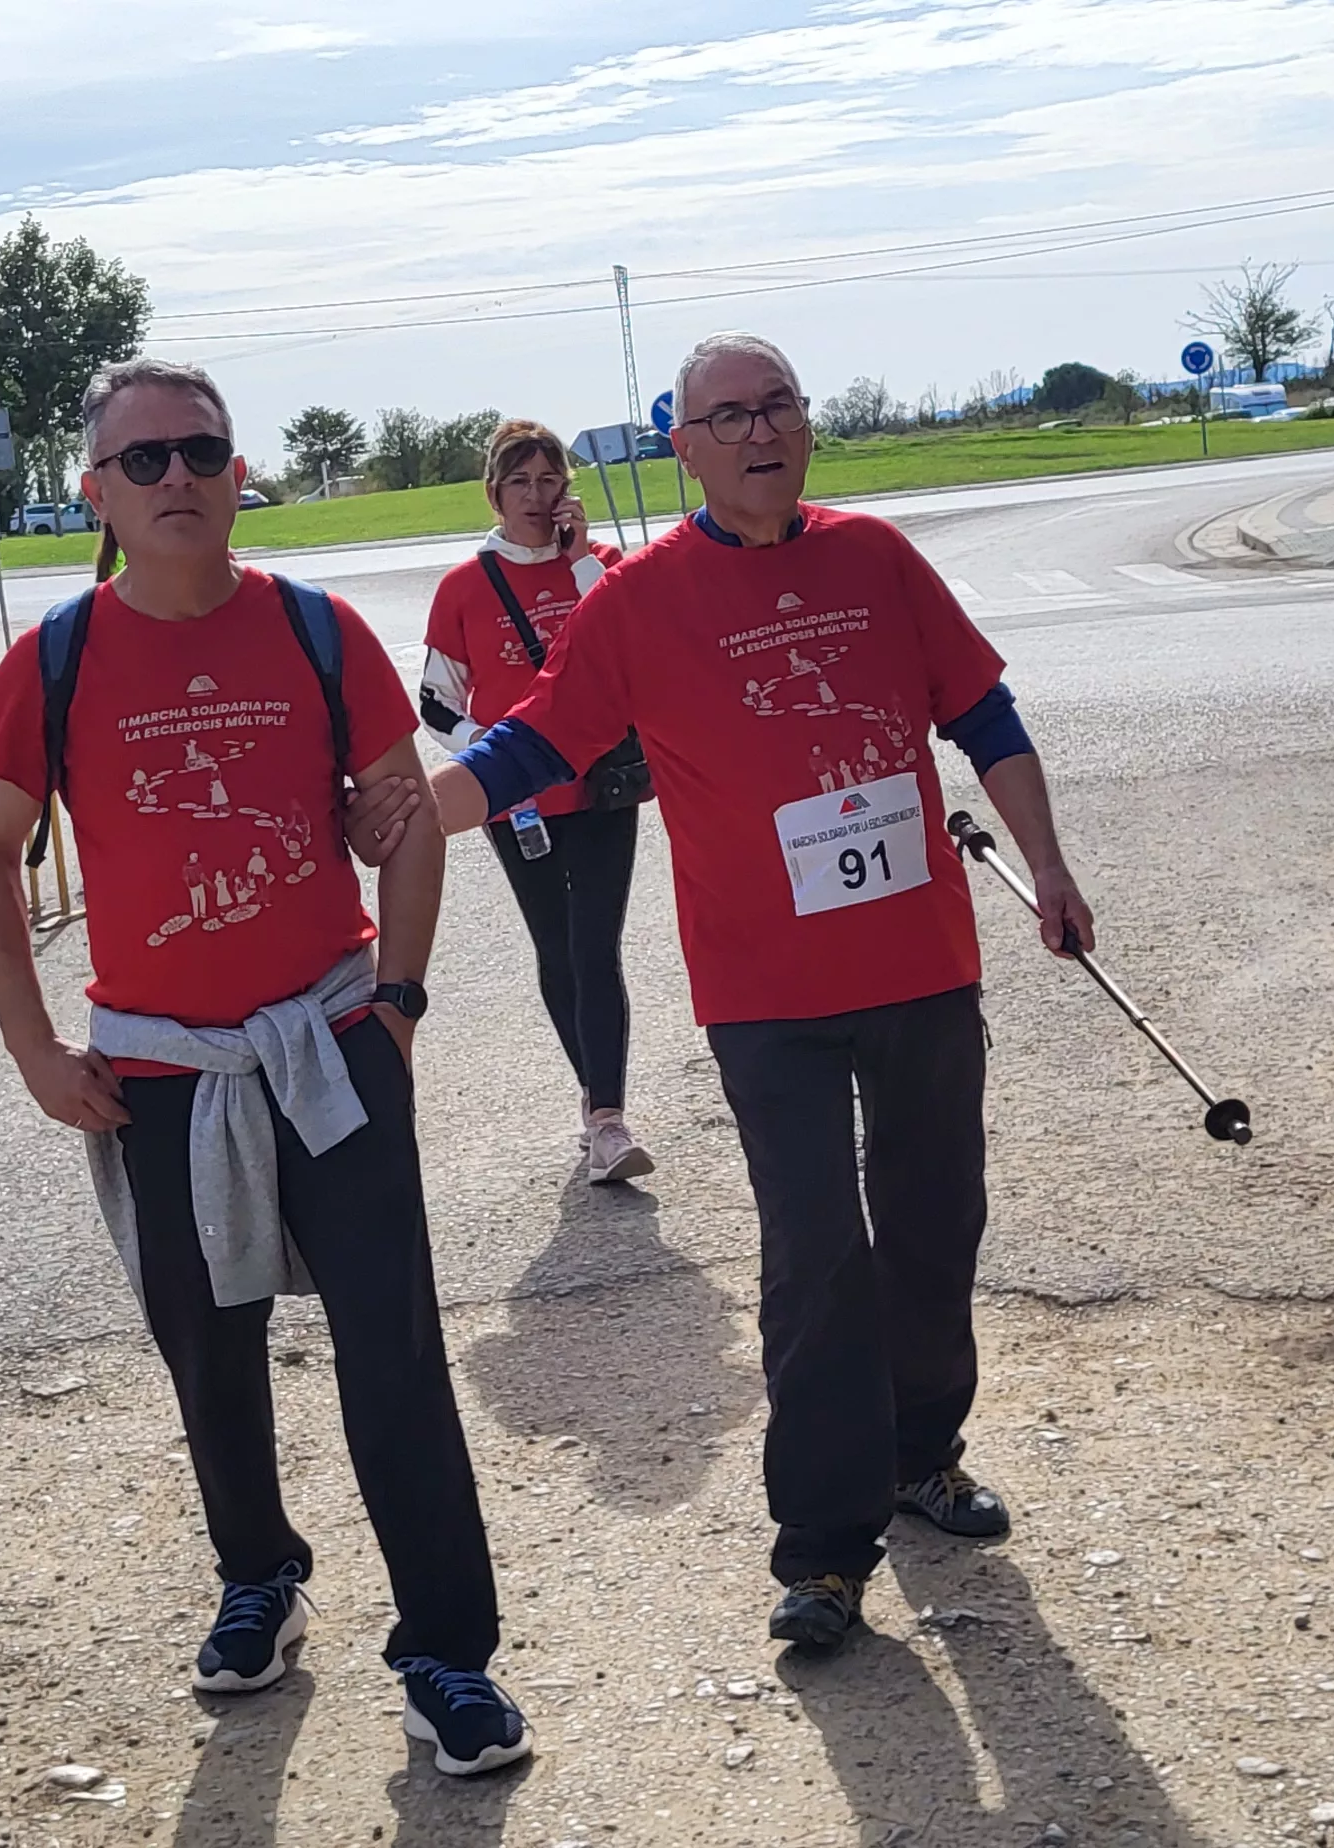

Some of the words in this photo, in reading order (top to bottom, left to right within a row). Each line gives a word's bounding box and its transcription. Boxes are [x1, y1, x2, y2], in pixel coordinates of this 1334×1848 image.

[729, 622, 784, 645] MARCHA
[785, 610, 846, 630] SOLIDARIA
[848, 607, 870, 618] POR
[729, 646, 745, 659] LA
[747, 629, 816, 653] ESCLEROSIS
[817, 620, 869, 636] MÚLTIPLE
[118, 718, 126, 730] II
[128, 707, 188, 728] MARCHA
[191, 701, 262, 717] SOLIDARIA
[264, 701, 291, 712] POR
[125, 730, 141, 743] LA
[144, 719, 223, 739] ESCLEROSIS
[225, 713, 286, 729] MÚLTIPLE
[838, 839, 892, 889] 91
